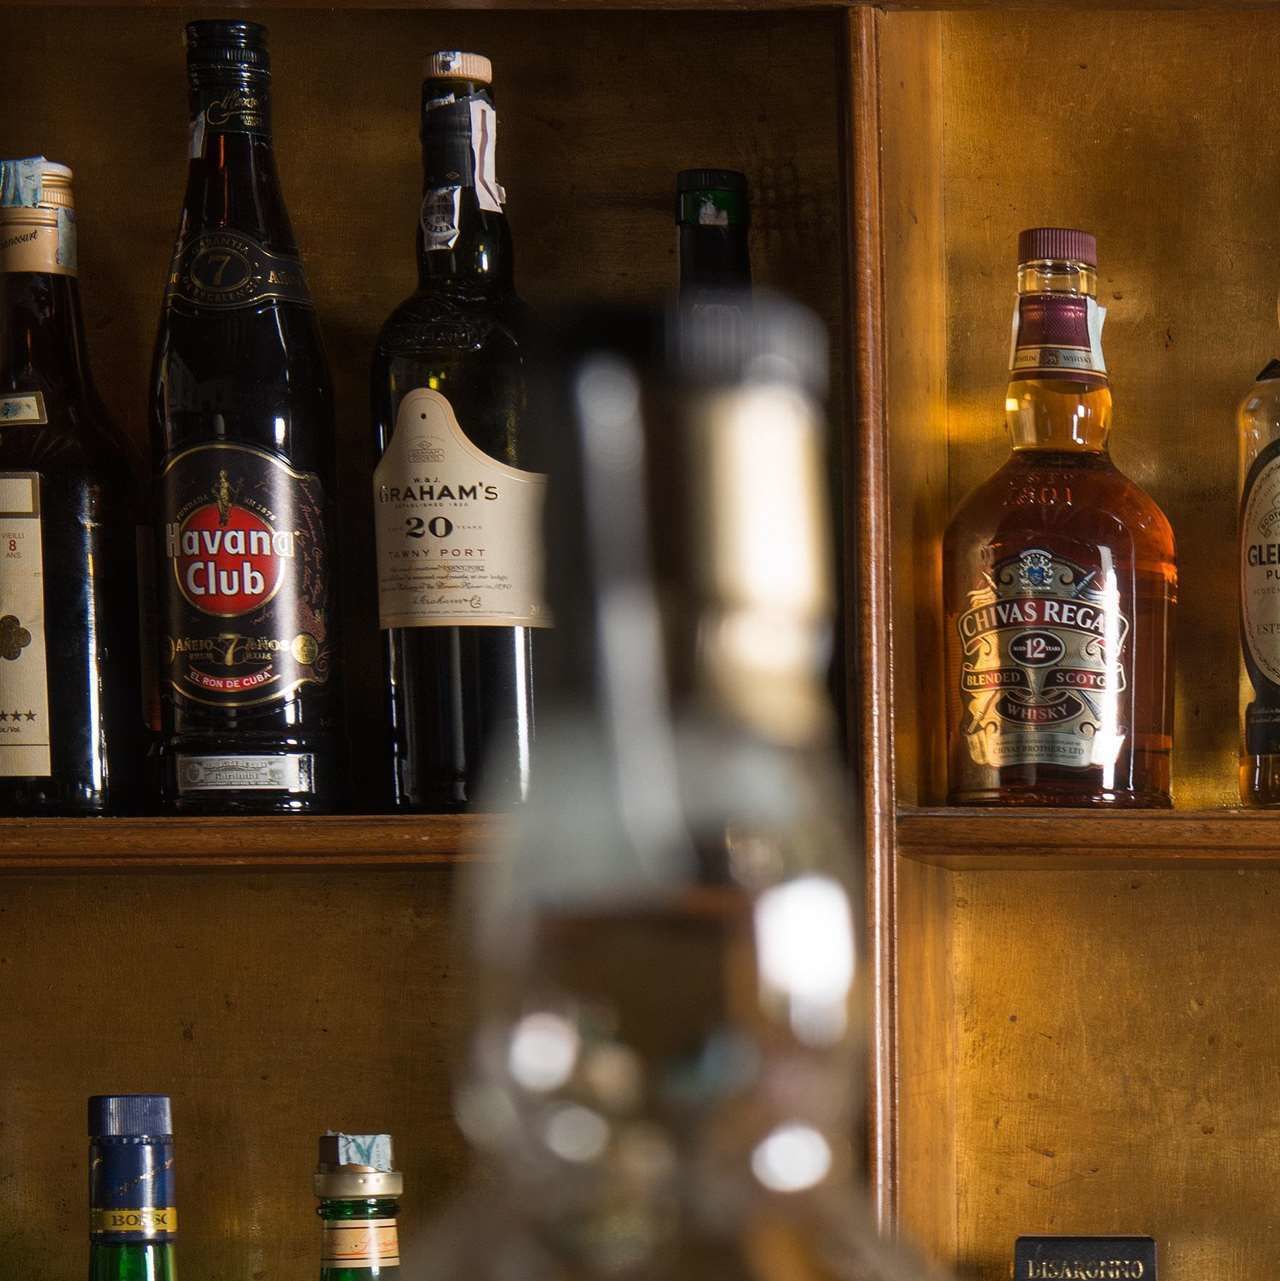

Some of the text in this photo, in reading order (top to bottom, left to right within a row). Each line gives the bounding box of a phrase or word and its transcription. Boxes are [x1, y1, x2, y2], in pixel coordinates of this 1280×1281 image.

[379, 482, 498, 503] GRAHAM'S
[405, 516, 454, 539] 20
[9, 539, 17, 552] 8
[166, 522, 296, 558] Havana
[388, 549, 486, 558] TAWNY PORT
[187, 561, 266, 596] Club
[963, 599, 1107, 637] CHIVAS REGA
[219, 633, 241, 666] 7
[1025, 638, 1046, 659] 12
[202, 677, 224, 688] RON
[226, 678, 241, 688] DE
[243, 671, 272, 688] CUBA
[967, 671, 1107, 686] BLENDED SCOTC
[1007, 703, 1069, 721] WHISKY
[1027, 1260, 1144, 1281] DISARONNO
